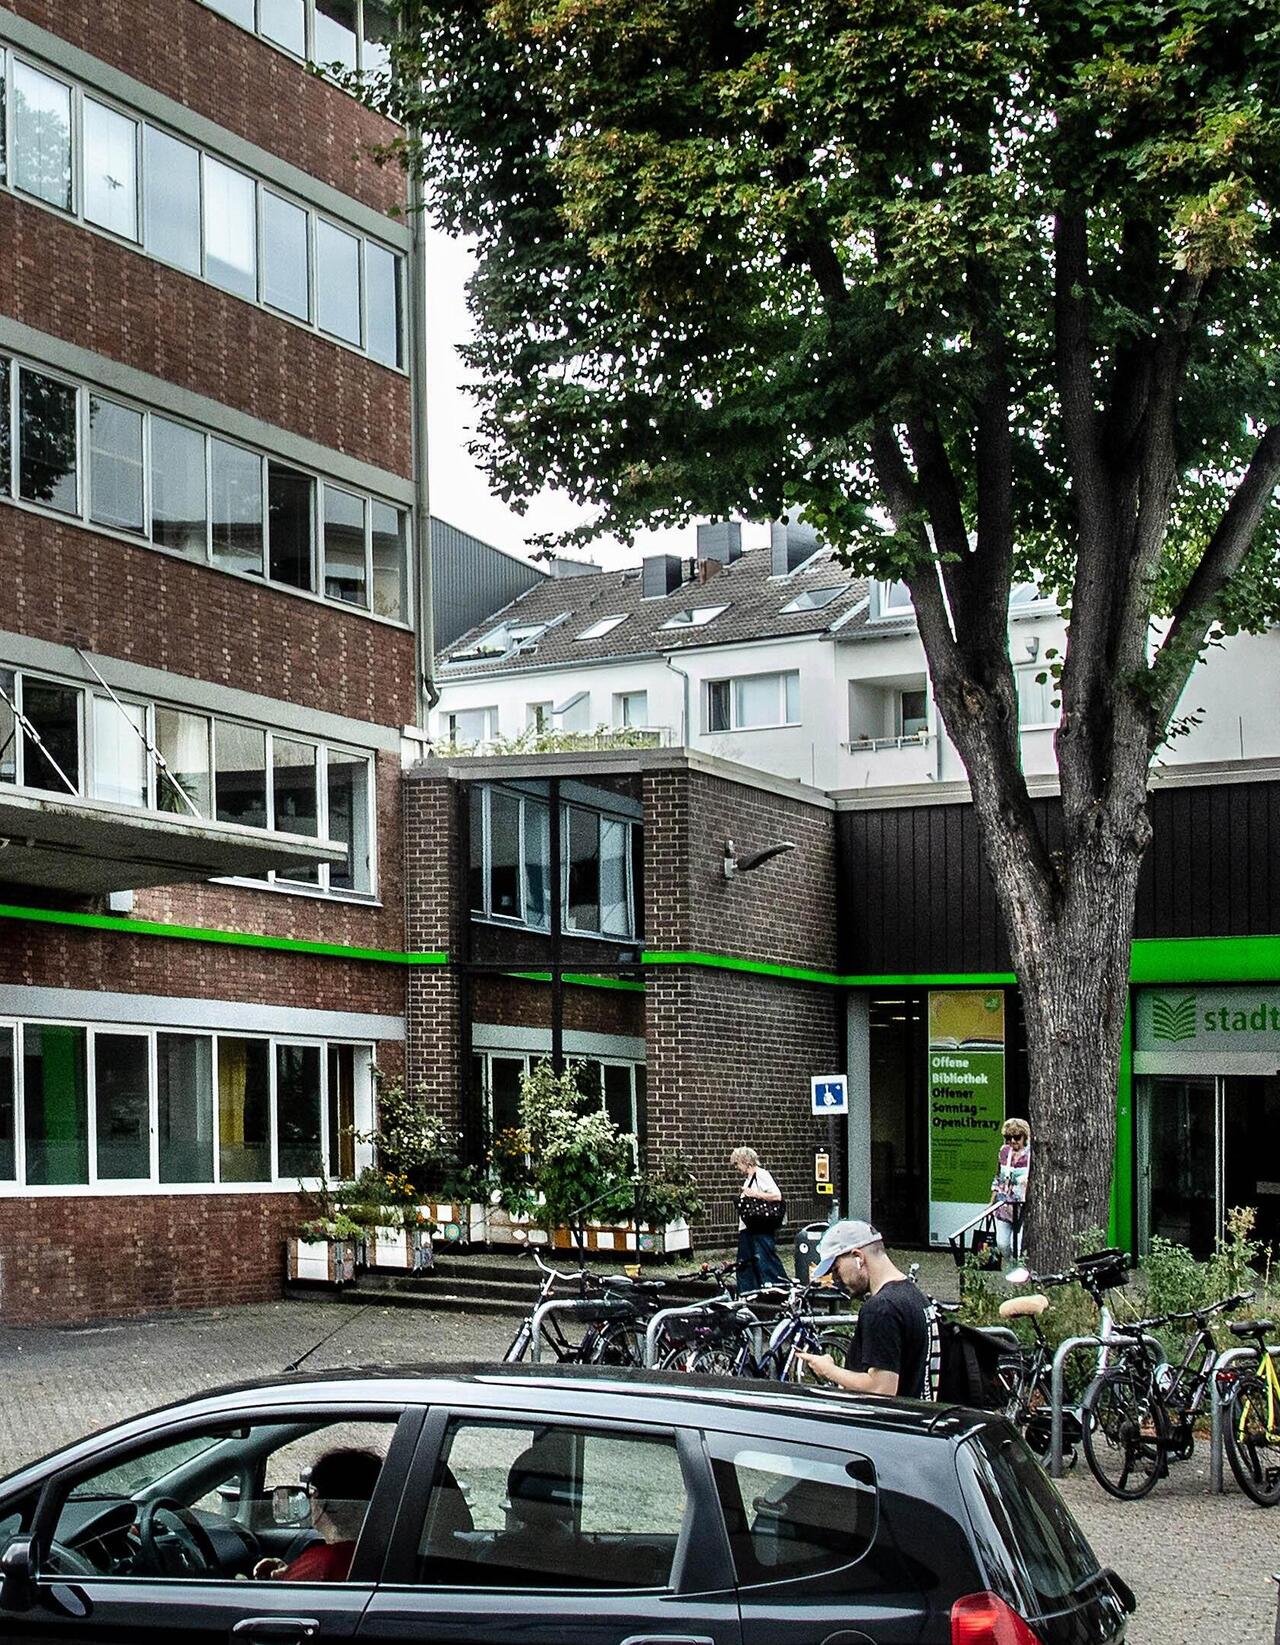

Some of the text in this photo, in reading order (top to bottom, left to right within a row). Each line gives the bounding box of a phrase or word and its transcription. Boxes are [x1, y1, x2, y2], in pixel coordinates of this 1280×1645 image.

[932, 1056, 970, 1068] Offene
[932, 1073, 989, 1085] Bibliothek
[932, 1087, 974, 1099] Offener
[932, 1102, 977, 1116] Sonntag
[932, 1117, 1000, 1131] OpenLibrary
